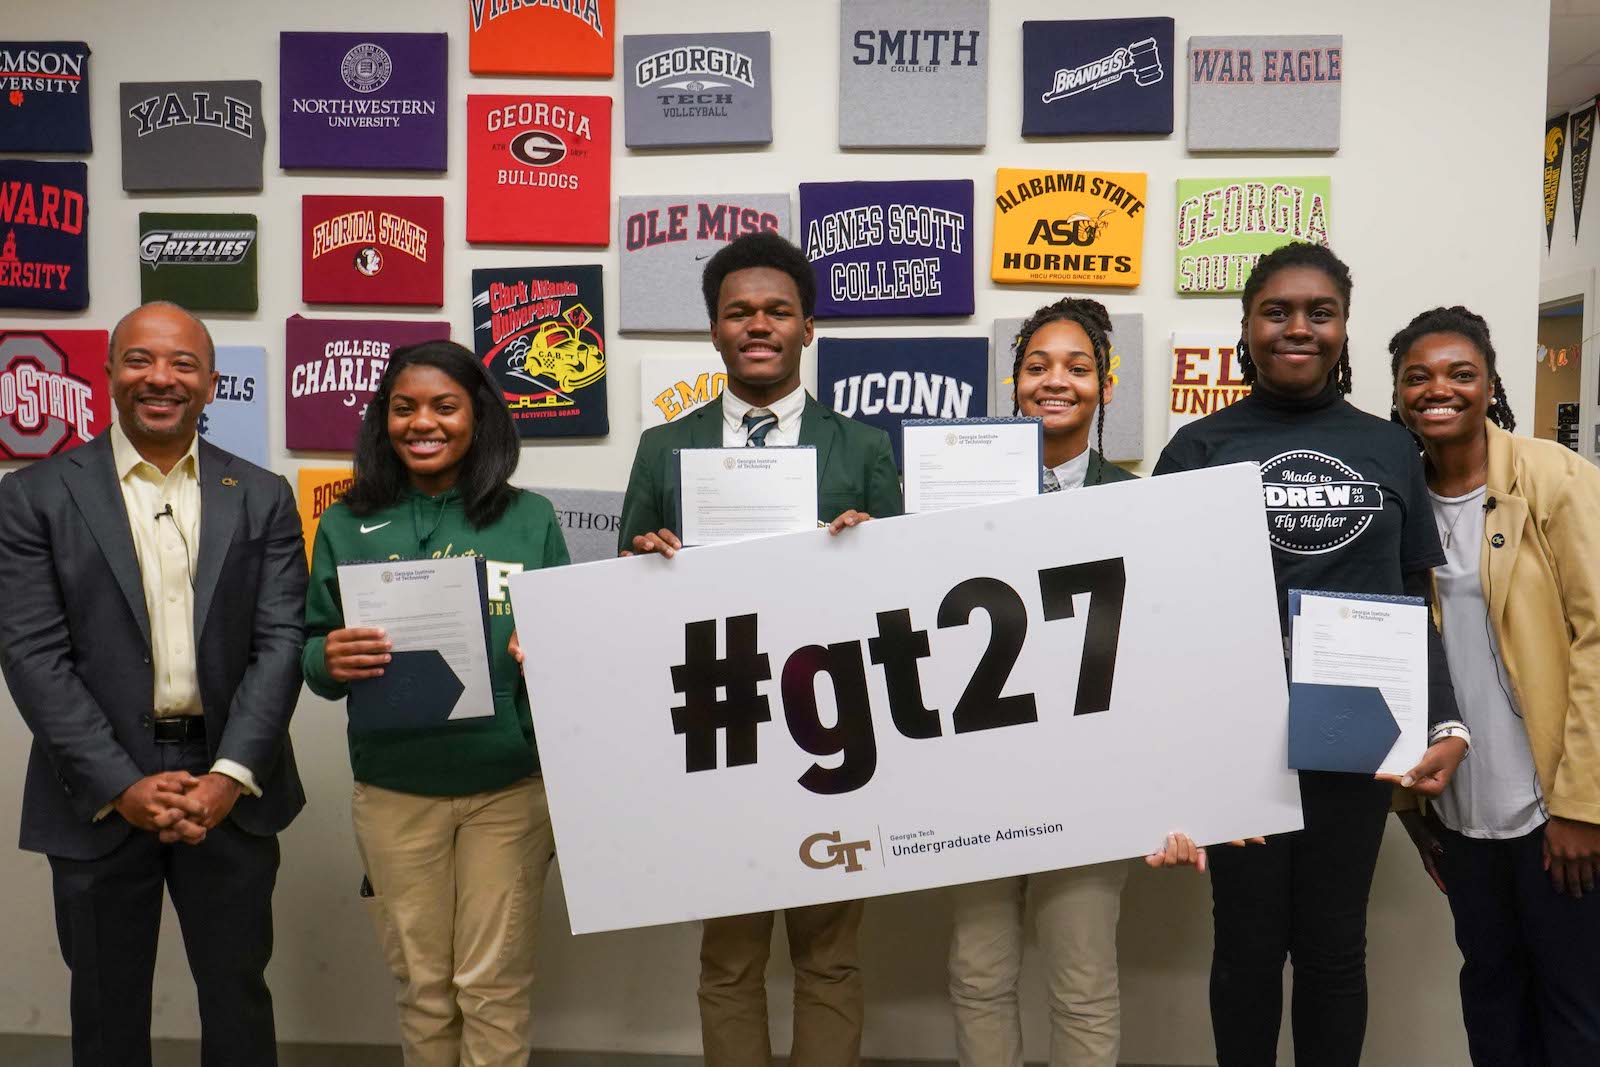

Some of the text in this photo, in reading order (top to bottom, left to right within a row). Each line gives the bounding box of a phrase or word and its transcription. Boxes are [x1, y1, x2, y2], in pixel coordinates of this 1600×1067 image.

[0, 50, 84, 76] MSON
[853, 30, 980, 66] SMITH
[636, 46, 755, 88] GEORGIA
[1056, 50, 1125, 93] BRANDEIS
[1192, 48, 1341, 84] WAR EAGLE
[129, 91, 253, 139] YALE
[292, 98, 436, 115] NORTHWESTERN
[657, 94, 733, 105] TECH
[663, 106, 728, 118] VOLLEYBALL
[328, 116, 400, 128] UNIVERSITY
[487, 103, 592, 141] GEORGIA
[497, 169, 579, 190] BULLDOGS
[996, 173, 1145, 218] ALABAMA STATE
[626, 203, 779, 252] OLE MISS
[806, 204, 965, 262] AGNES SCOTT
[1027, 219, 1097, 247] ASU
[1177, 182, 1330, 250] GEORGIA
[140, 234, 248, 262] GRIZZLIES
[313, 210, 428, 263] FLORIDA STATE
[831, 257, 942, 302] COLLEGE
[1003, 252, 1132, 273] HORNETS
[1179, 252, 1262, 292] SOUT
[490, 279, 578, 314] Clark Atlanta
[491, 299, 562, 345] University
[324, 340, 391, 359] COLLEGE
[291, 357, 390, 399] CHARLE
[832, 370, 974, 420] UCONN
[1171, 387, 1252, 415] UNIV
[1282, 470, 1332, 483] Made to
[1266, 485, 1363, 507] DREW 20
[1353, 495, 1364, 503] 23
[1275, 512, 1347, 532] Fly Higher
[670, 556, 1127, 795] #gt27
[890, 829, 936, 841] Georgia Tech
[892, 823, 1064, 857] Undergraduate Admission
